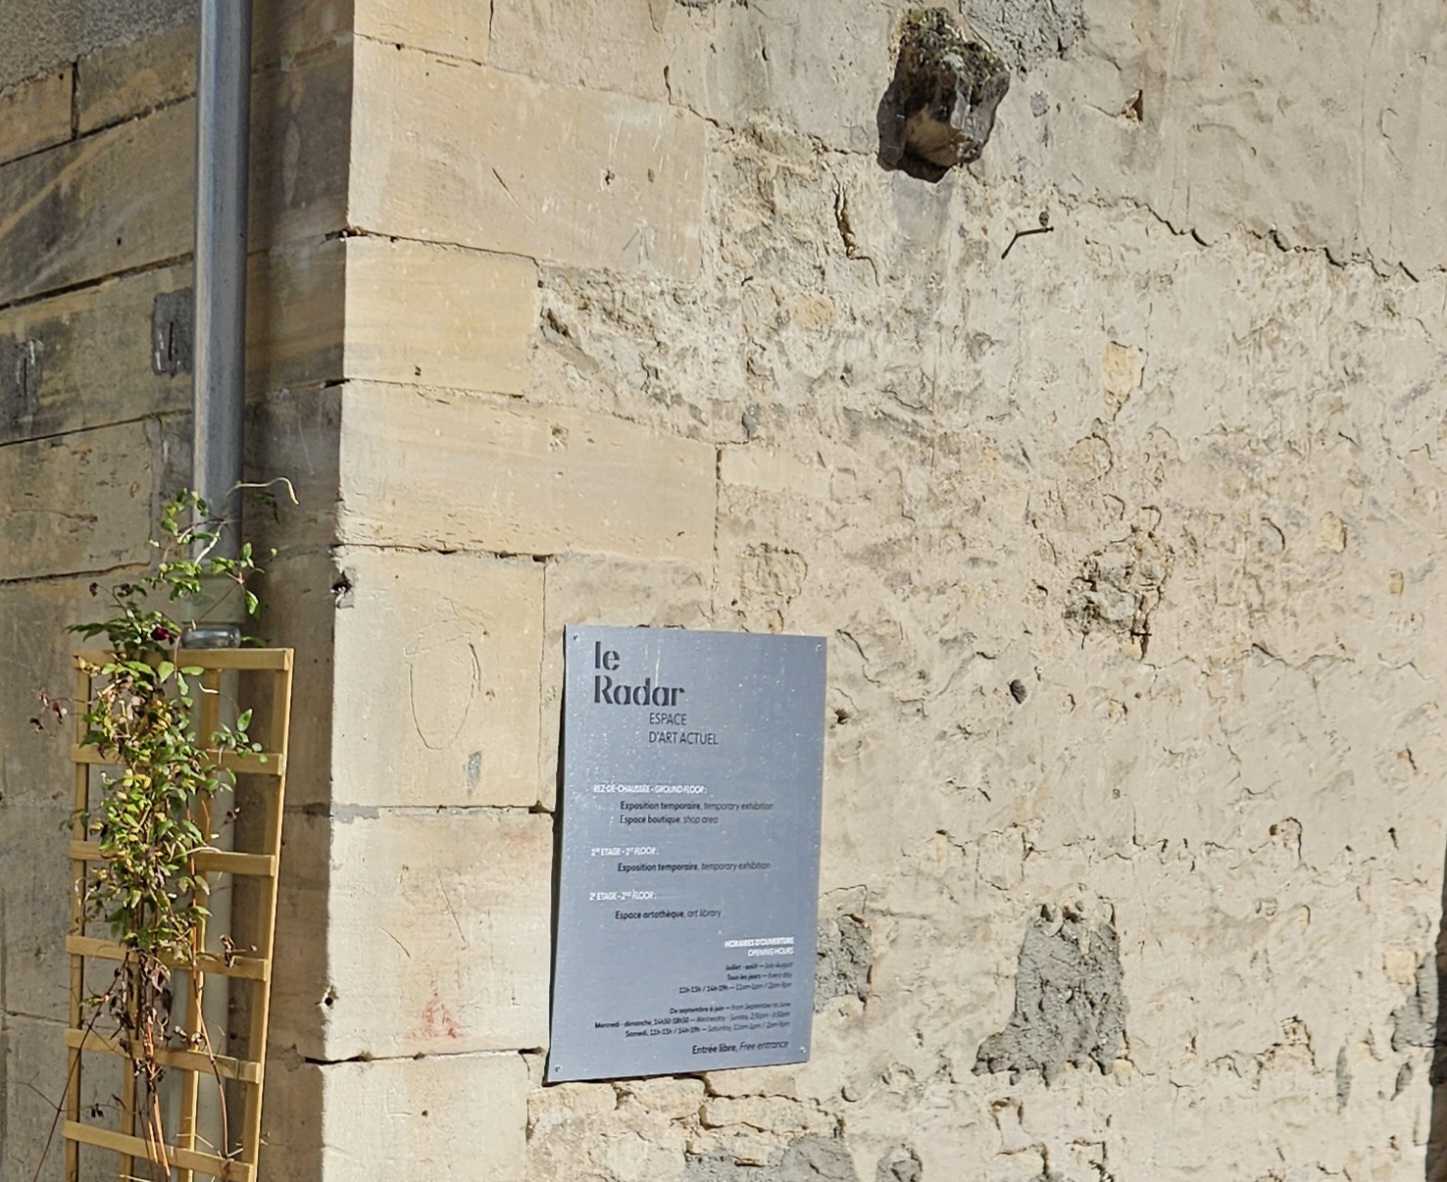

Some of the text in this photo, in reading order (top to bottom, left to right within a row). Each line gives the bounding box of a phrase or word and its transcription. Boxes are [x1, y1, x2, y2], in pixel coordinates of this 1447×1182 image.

[595, 641, 620, 670] le
[594, 675, 685, 706] Radar
[650, 712, 686, 725] ESPACE
[649, 731, 718, 745] D'ART ACTUEL
[620, 801, 659, 811] Exposition
[704, 802, 740, 812] temporary
[741, 802, 774, 810] exhibition
[620, 815, 646, 825] Espace
[683, 815, 700, 824] shop
[618, 863, 656, 873] Exposition
[701, 862, 737, 872] temporary
[738, 862, 771, 870] exhibition
[615, 910, 641, 920] Espace
[699, 909, 721, 918] library
[692, 1045, 717, 1054] Entrée
[740, 1041, 755, 1050] Free
